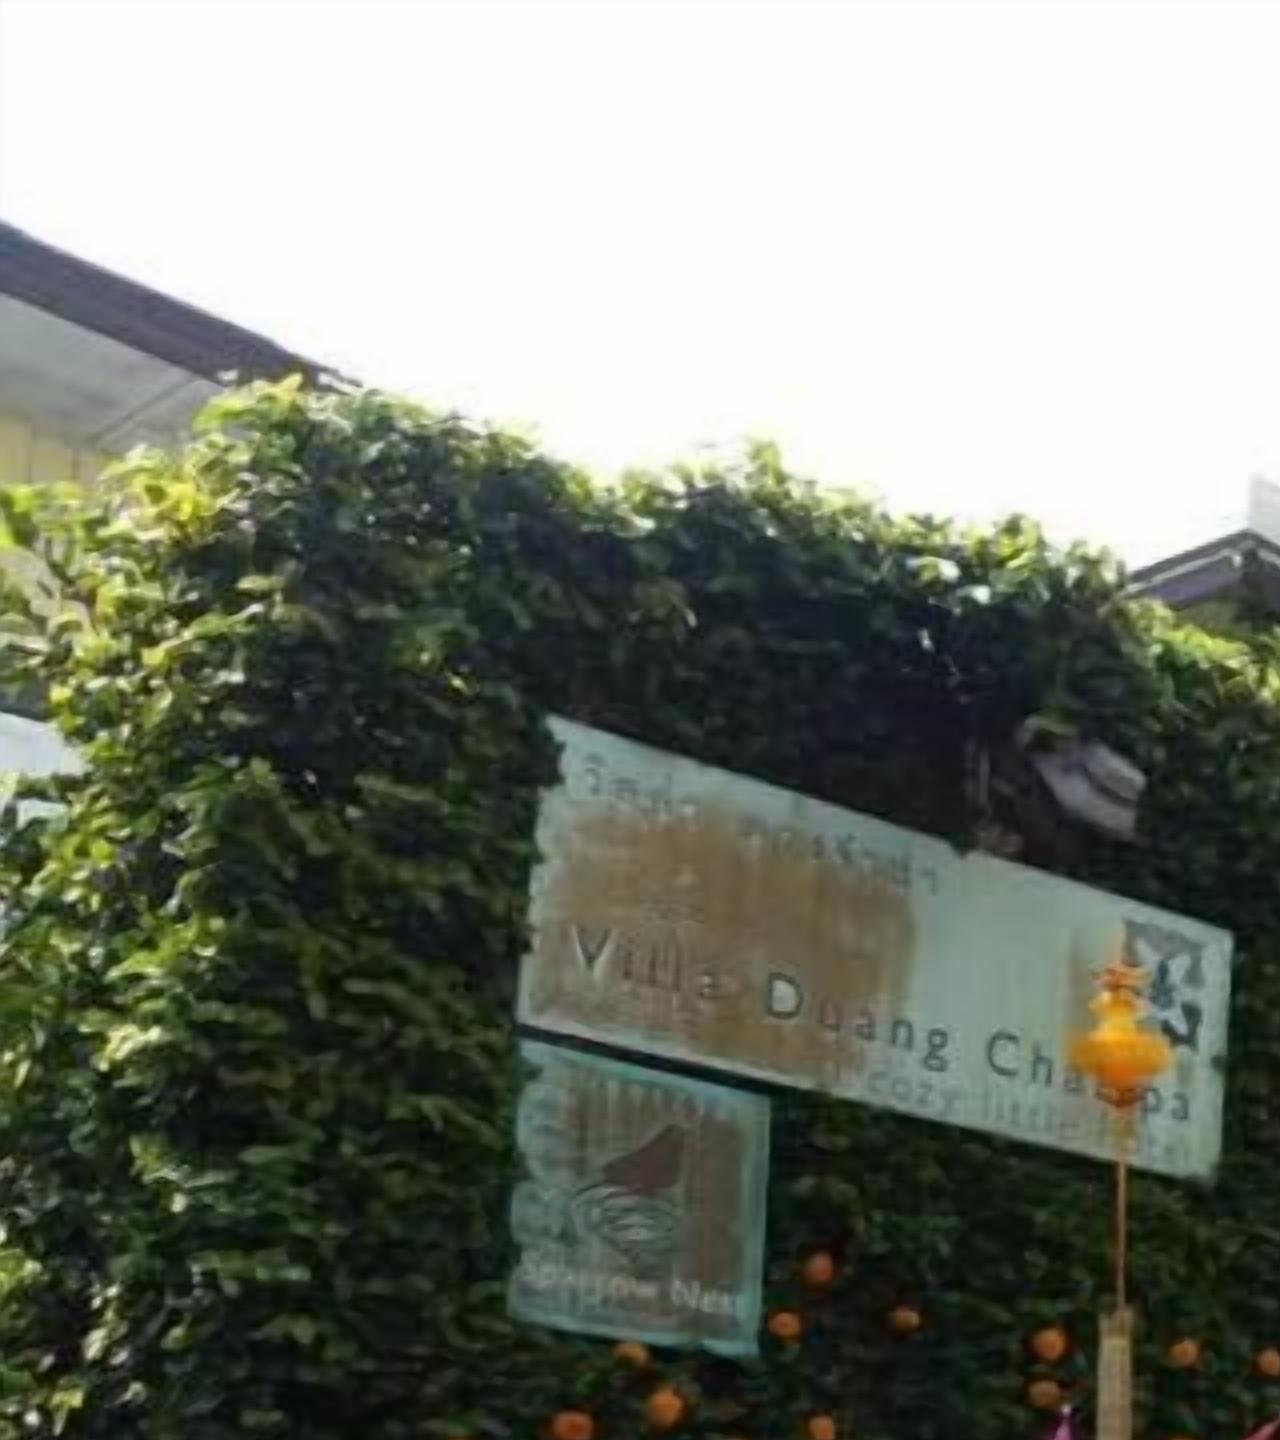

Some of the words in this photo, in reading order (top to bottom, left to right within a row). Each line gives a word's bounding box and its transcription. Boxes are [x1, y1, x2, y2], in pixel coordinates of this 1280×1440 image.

[570, 923, 722, 1000] Villa
[765, 968, 950, 1072] Duang
[985, 1027, 1190, 1122] Chapa
